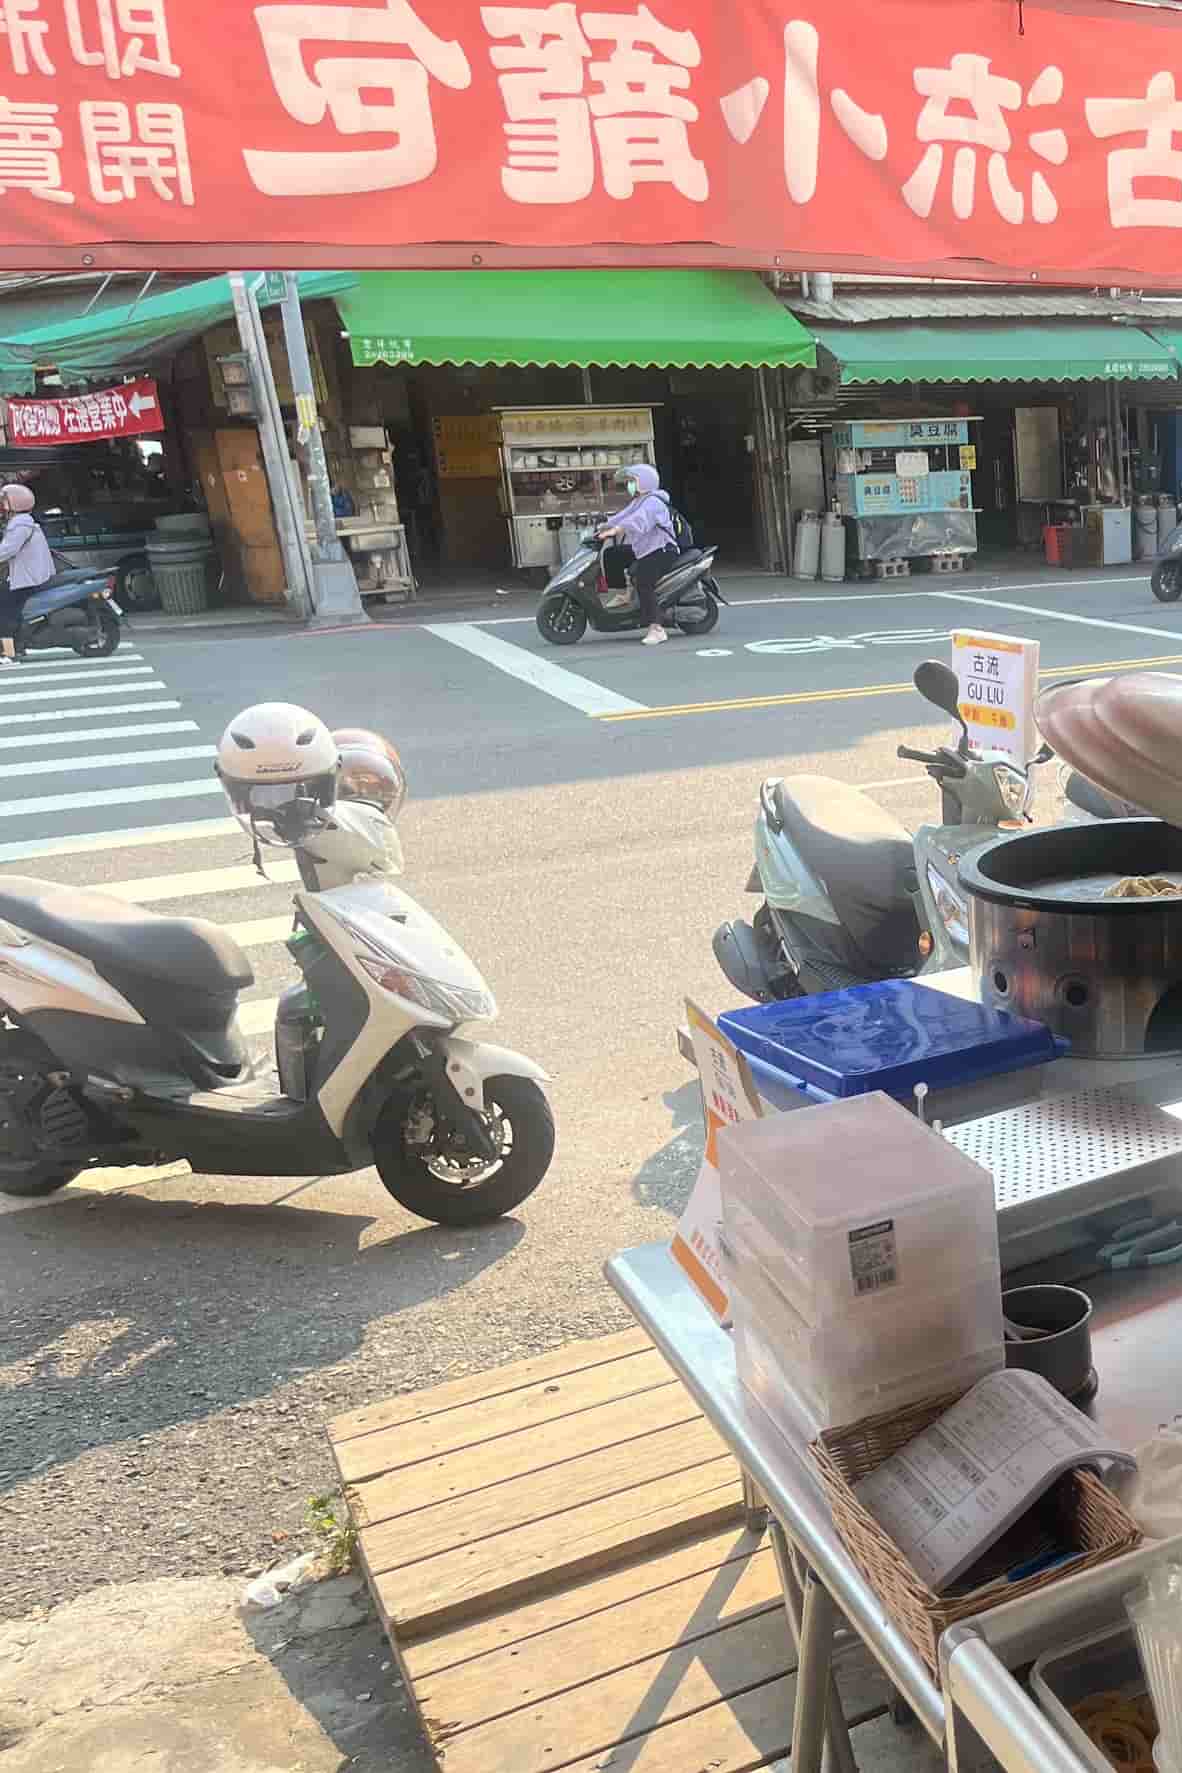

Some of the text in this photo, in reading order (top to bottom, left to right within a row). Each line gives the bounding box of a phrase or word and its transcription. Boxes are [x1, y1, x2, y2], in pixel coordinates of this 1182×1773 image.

[973, 652, 1000, 677] 古流
[967, 682, 1005, 705] GU LIU
